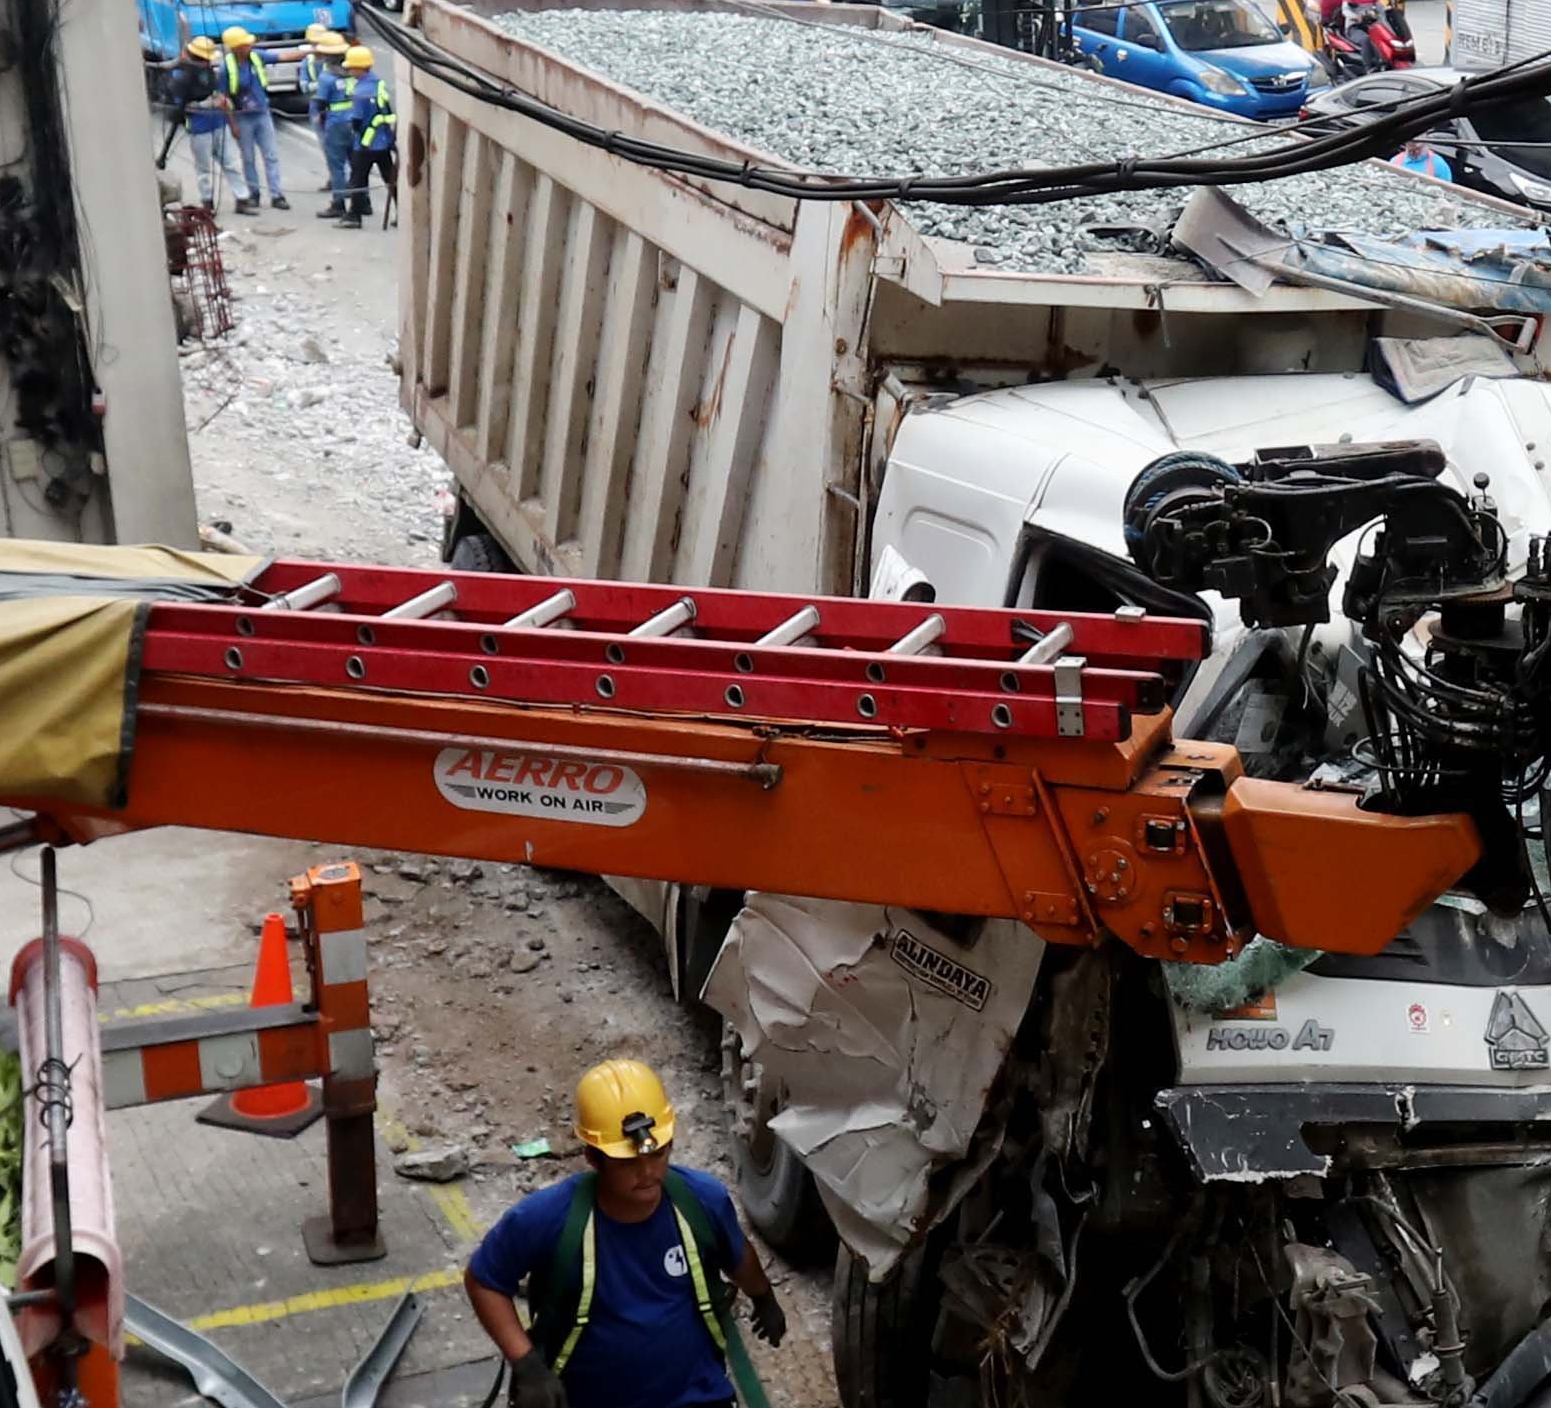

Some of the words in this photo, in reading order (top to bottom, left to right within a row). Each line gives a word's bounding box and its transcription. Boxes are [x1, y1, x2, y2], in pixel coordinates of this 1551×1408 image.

[446, 749, 625, 795] AERRO
[477, 787, 533, 804] WORK
[540, 794, 567, 809] ON
[572, 798, 603, 812] AIR
[896, 934, 988, 1001] ALINDAYA
[1204, 1026, 1287, 1053] HOWO
[1290, 1018, 1336, 1053] A7
